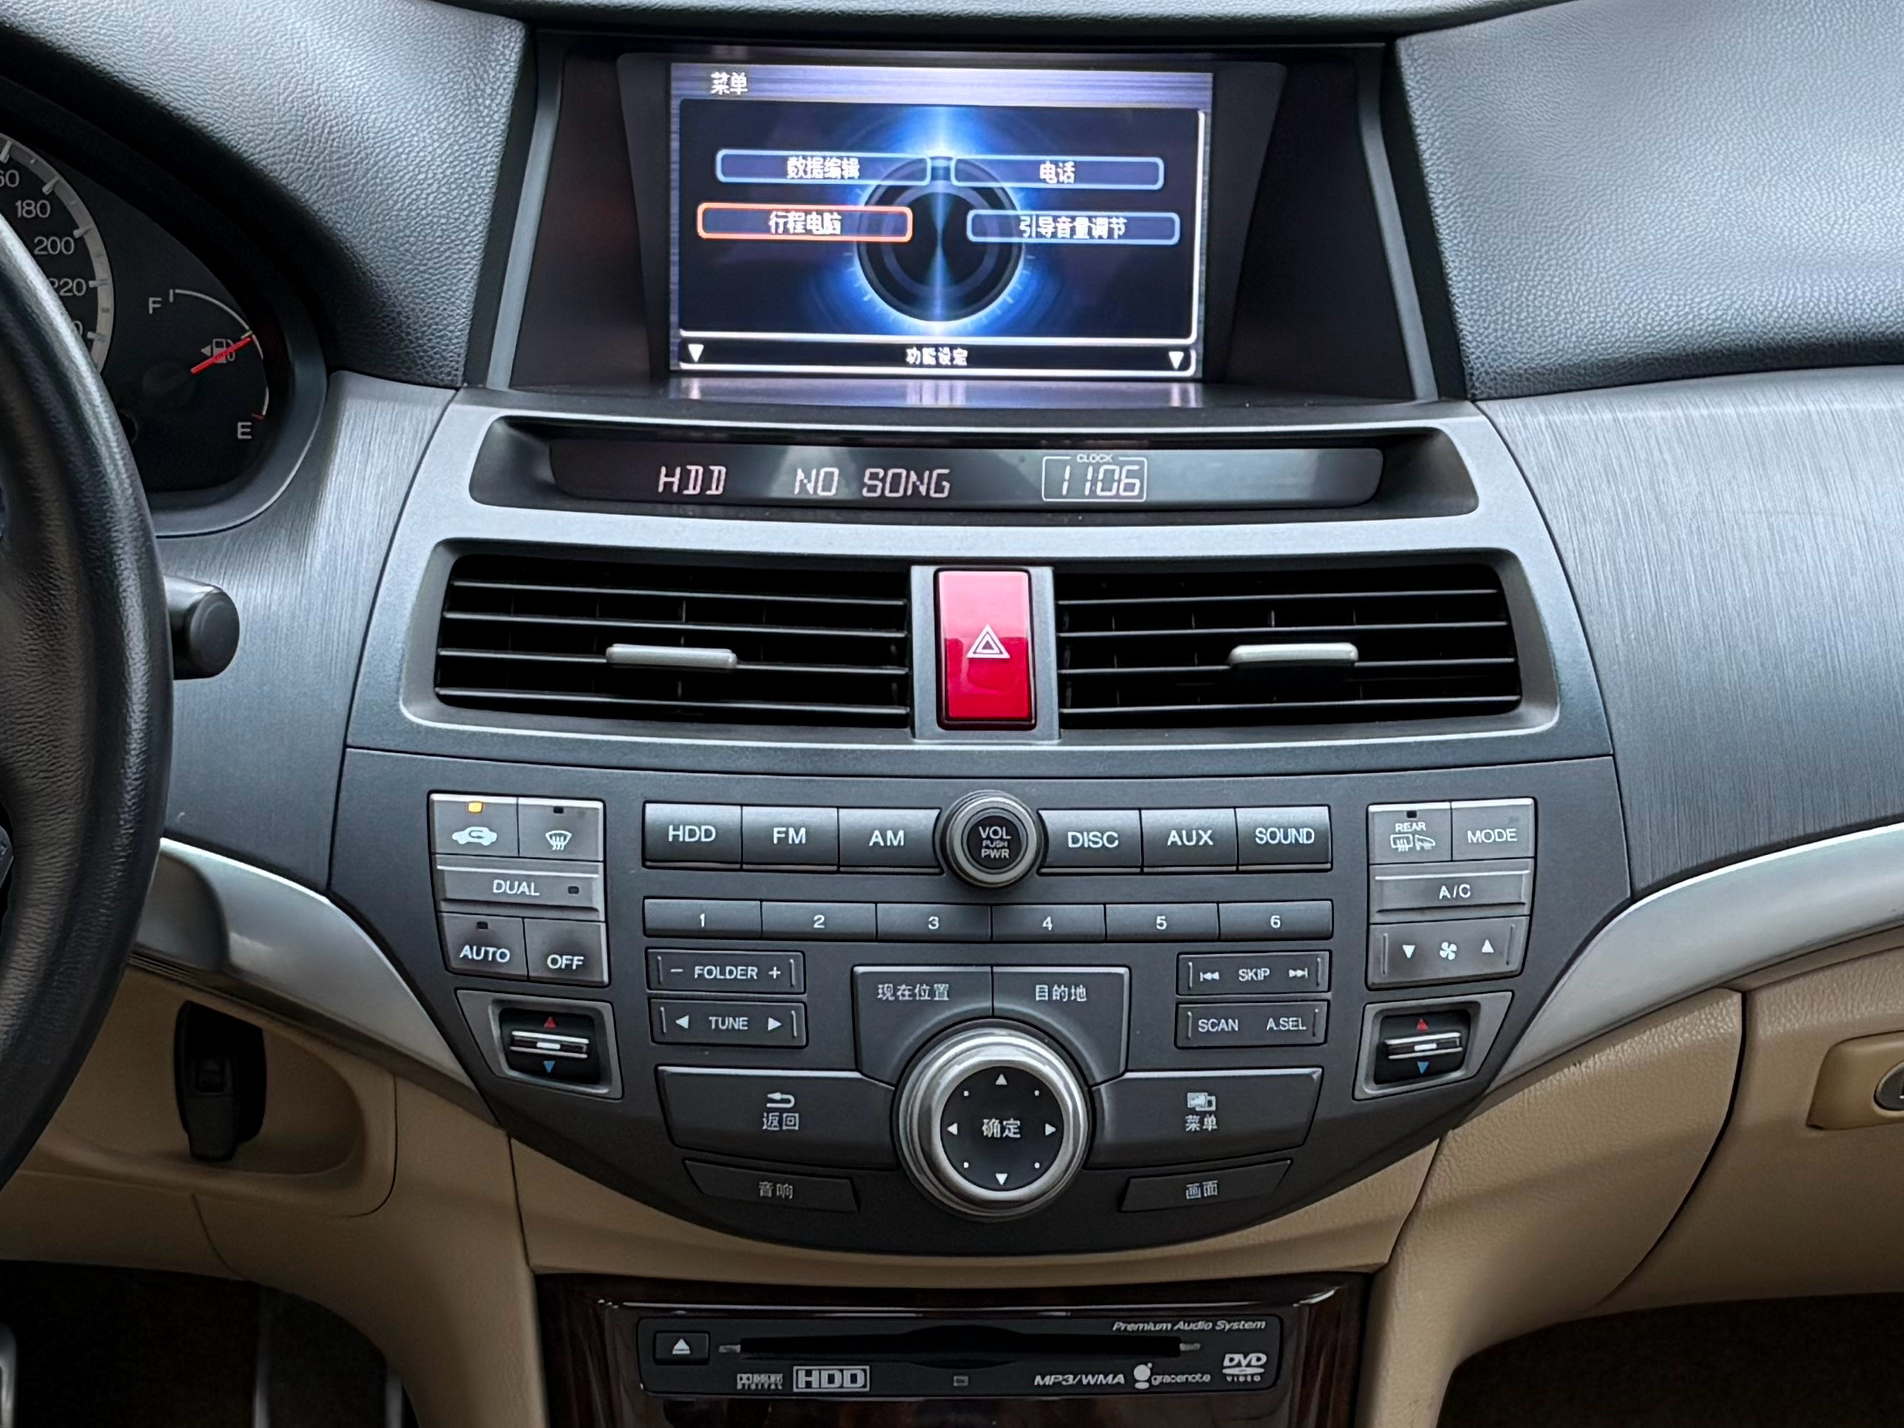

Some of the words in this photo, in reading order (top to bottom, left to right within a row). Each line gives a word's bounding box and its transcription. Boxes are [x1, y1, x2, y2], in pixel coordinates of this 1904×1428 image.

[709, 71, 748, 96] 菜单
[786, 156, 861, 180] 数据编辑
[1038, 160, 1076, 184] 电话
[14, 199, 51, 219] 180
[768, 210, 842, 235] 行程电脑
[1018, 215, 1128, 240] 引导音量调节
[33, 236, 75, 255] 200
[147, 297, 162, 316] F
[905, 345, 969, 367] 功能设定
[237, 421, 253, 440] E
[1076, 453, 1114, 464] CLOCK
[657, 465, 727, 496] HDD
[794, 467, 840, 497] NO
[862, 468, 951, 499] SONG
[667, 824, 717, 844] HDD
[772, 826, 807, 846] FM
[978, 825, 1012, 840] VOL
[1254, 825, 1316, 846] SOUND
[1394, 821, 1428, 833] REAR
[1467, 827, 1518, 845] MODE
[868, 828, 906, 848] AM
[1067, 830, 1120, 850] DISC
[1166, 828, 1214, 847] AUX
[981, 848, 1010, 859] PWR
[492, 879, 540, 897] DUAL
[1438, 882, 1472, 900] A/C
[698, 913, 707, 929] 1
[812, 914, 826, 930] 2
[927, 915, 940, 931] 3
[1041, 915, 1054, 931] 4
[1155, 915, 1167, 931] 5
[1270, 914, 1282, 930] 6
[458, 944, 511, 964] AUTO
[546, 953, 585, 972] OFF
[693, 964, 759, 981] FOLDER
[1237, 966, 1271, 983] SKIP
[876, 982, 951, 1002] 现在位置
[1034, 983, 1088, 1003] 目的地
[708, 1015, 749, 1031] TUNE
[1197, 1017, 1240, 1033] SCAN
[1266, 1017, 1308, 1033] A.SEL
[761, 1111, 800, 1133] 返回
[981, 1118, 1022, 1140] 确定
[1184, 1113, 1219, 1133] 菜单
[758, 1181, 795, 1200] 音响
[1185, 1179, 1218, 1200] 画面
[1112, 1320, 1172, 1332] Premium
[1173, 1320, 1213, 1331] Audio
[1214, 1319, 1267, 1332] System
[1222, 1352, 1268, 1367] DVD
[797, 1369, 866, 1389] HDD
[1033, 1373, 1126, 1387] MP3/WMA
[1150, 1373, 1212, 1387] gracenote
[1225, 1374, 1262, 1383] VIDEO
